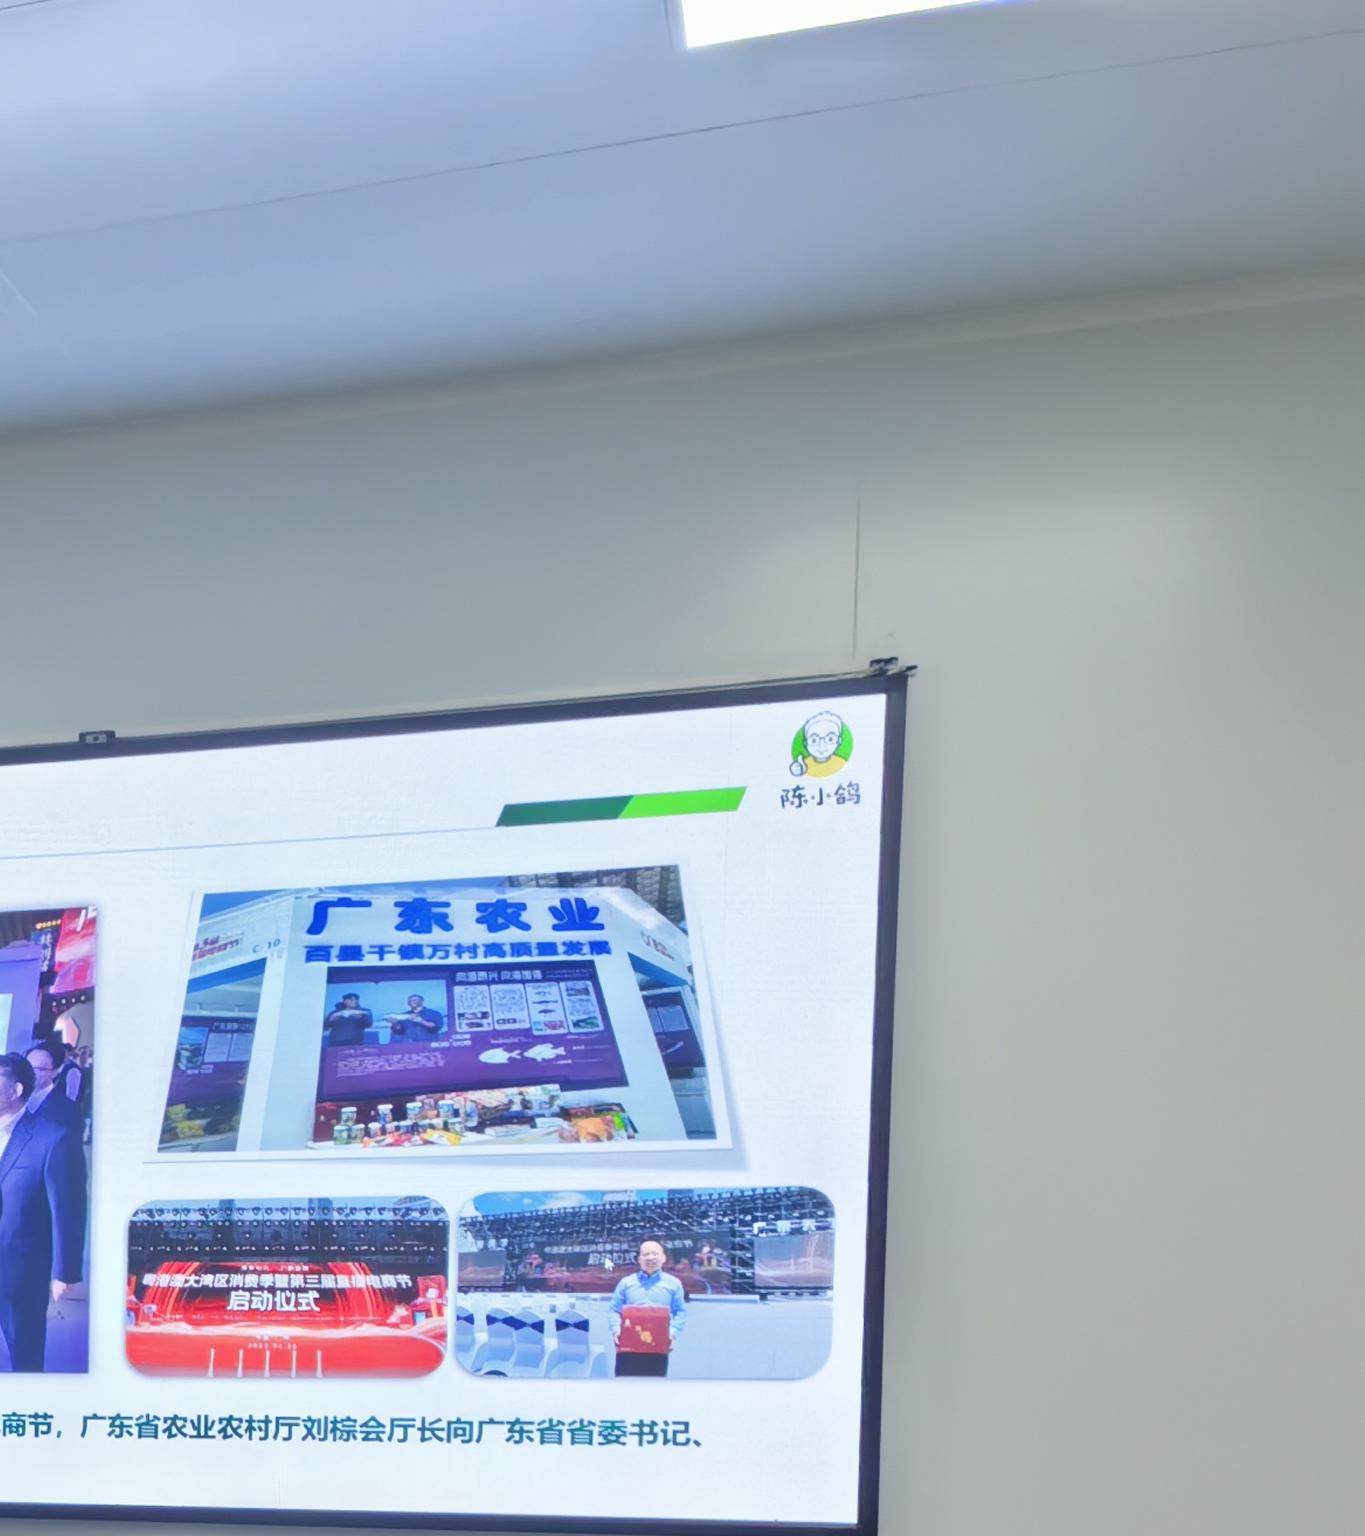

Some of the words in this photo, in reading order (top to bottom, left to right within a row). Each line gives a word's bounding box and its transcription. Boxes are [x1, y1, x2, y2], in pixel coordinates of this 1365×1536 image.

[780, 781, 861, 809] 陈小鸽
[305, 897, 605, 936] 广东农业
[226, 1290, 321, 1312] 启动仪式
